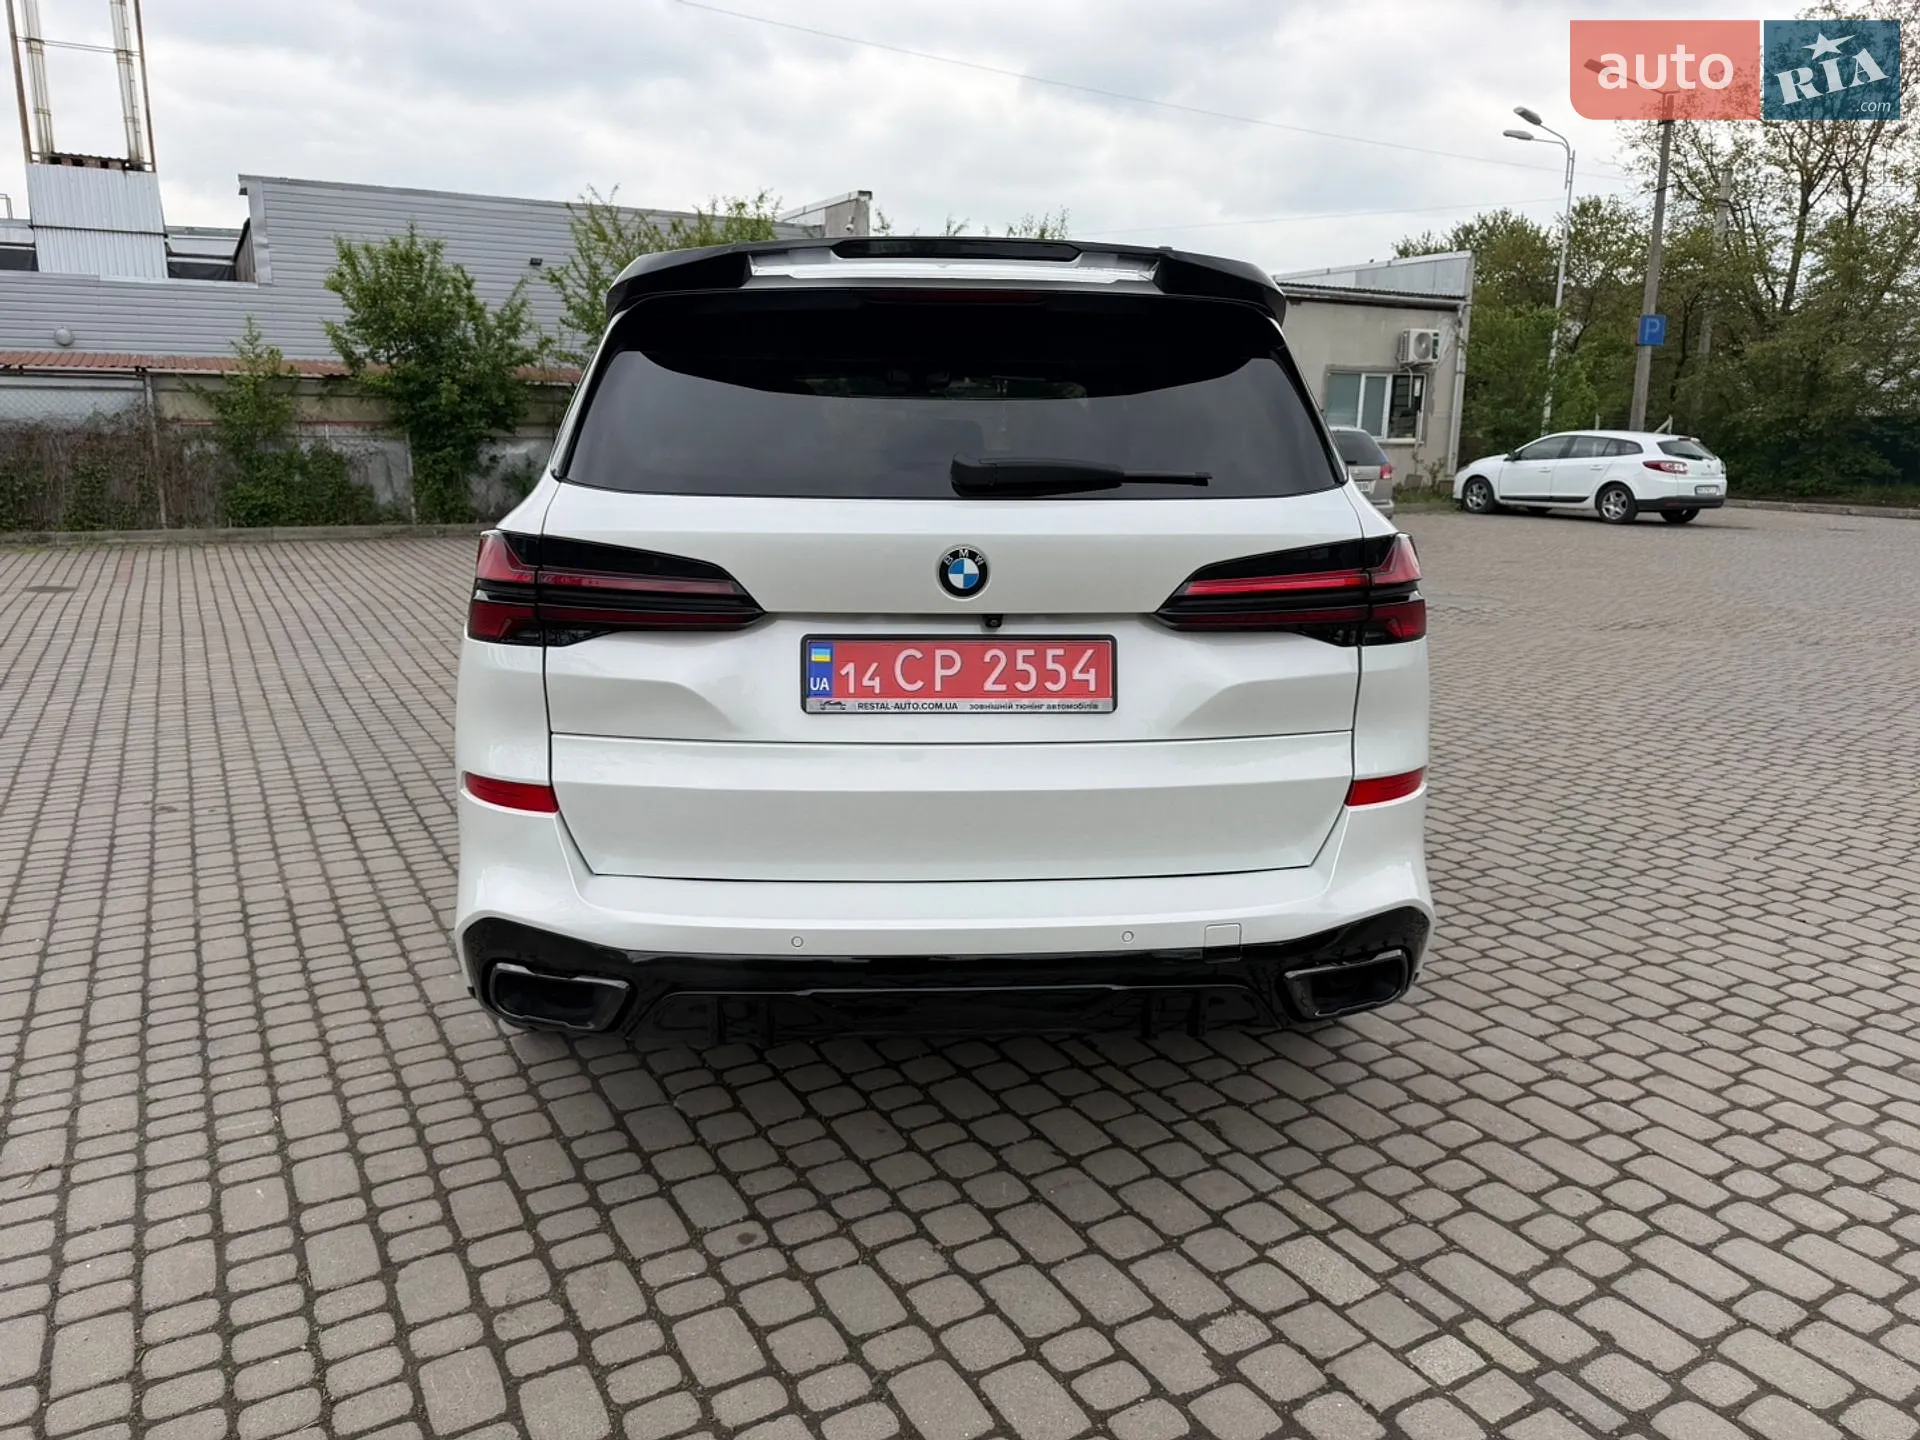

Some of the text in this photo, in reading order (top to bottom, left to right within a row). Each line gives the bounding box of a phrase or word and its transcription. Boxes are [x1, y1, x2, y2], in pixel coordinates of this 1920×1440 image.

[1645, 317, 1660, 341] P
[943, 548, 985, 566] BMW
[839, 648, 1097, 695] 14 CP 2554
[809, 677, 830, 691] UA
[857, 702, 959, 711] RESTAL-AUTO.COM.UA
